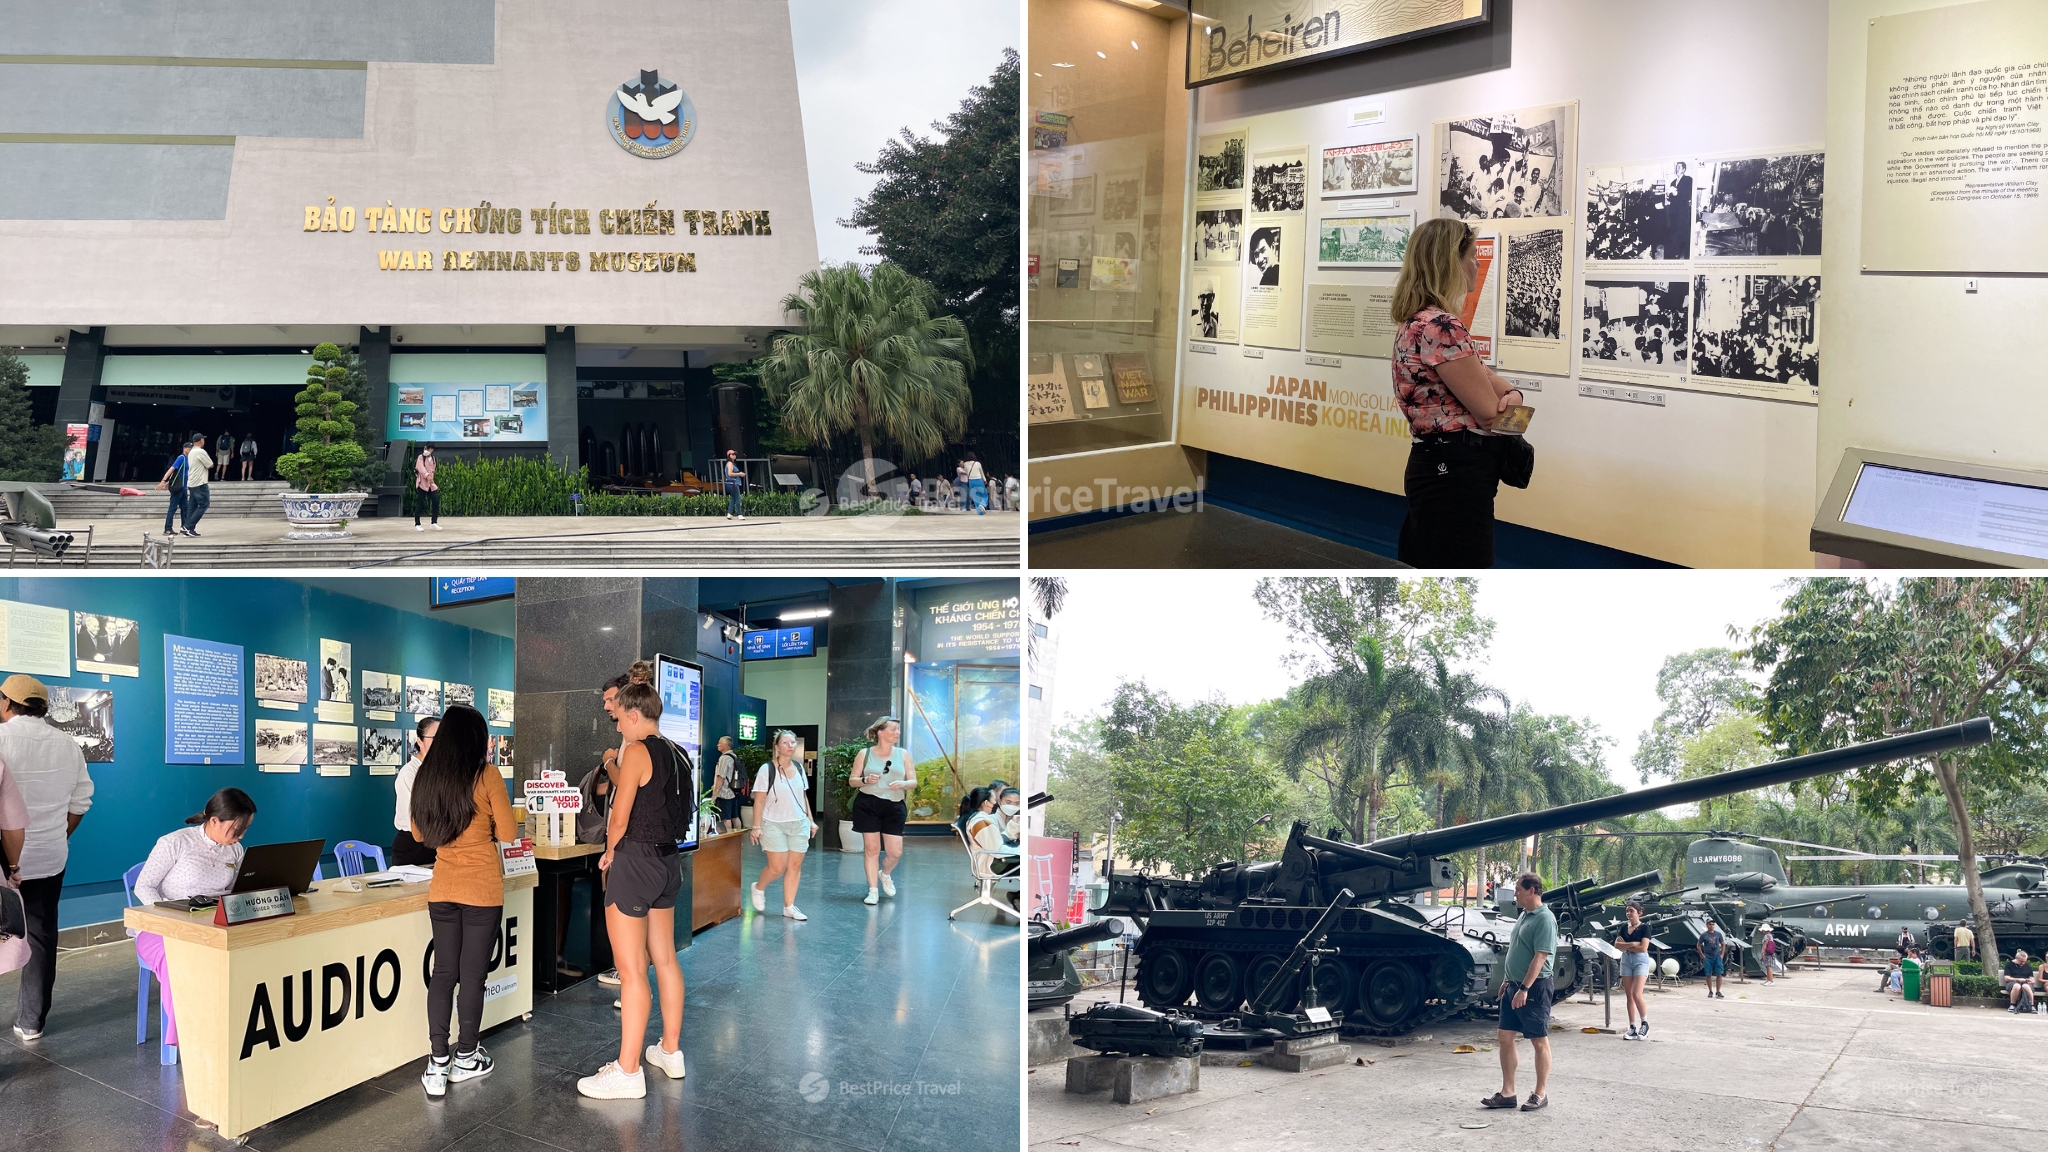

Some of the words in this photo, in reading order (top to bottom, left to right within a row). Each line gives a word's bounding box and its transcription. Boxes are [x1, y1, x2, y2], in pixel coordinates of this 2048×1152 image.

[1208, 10, 1340, 73] Beheiren
[303, 196, 356, 232] BẢO
[365, 200, 432, 233] TÀNG
[439, 200, 522, 233] CHỨNG
[531, 201, 590, 234] TÍCH
[600, 200, 675, 235] CHIẾN
[683, 210, 772, 235] TRANH
[378, 250, 433, 270] WAR
[442, 250, 581, 271] REMNANTS
[590, 252, 696, 272] MUSEUM
[1118, 370, 1145, 379] VIET-
[1120, 378, 1146, 388] NAM
[1122, 388, 1149, 398] WAR
[1266, 375, 1327, 402] JAPAN
[1328, 389, 1399, 413] MONGOLIA
[1198, 387, 1318, 427] PHILIPPINES
[1321, 405, 1382, 435] KOREA
[451, 585, 475, 594] RECEPTION
[929, 602, 950, 614] THẾ
[953, 601, 974, 611] GIỚI
[1002, 596, 1018, 608] HỘ
[935, 613, 971, 624] KHÁNG
[975, 609, 1005, 621] CHIẾN
[972, 622, 994, 631] 1954
[246, 896, 272, 906] HƯỚNG
[1825, 923, 1870, 937] ARMY
[501, 982, 517, 991] vietnam
[239, 948, 401, 1061] AUDIO
